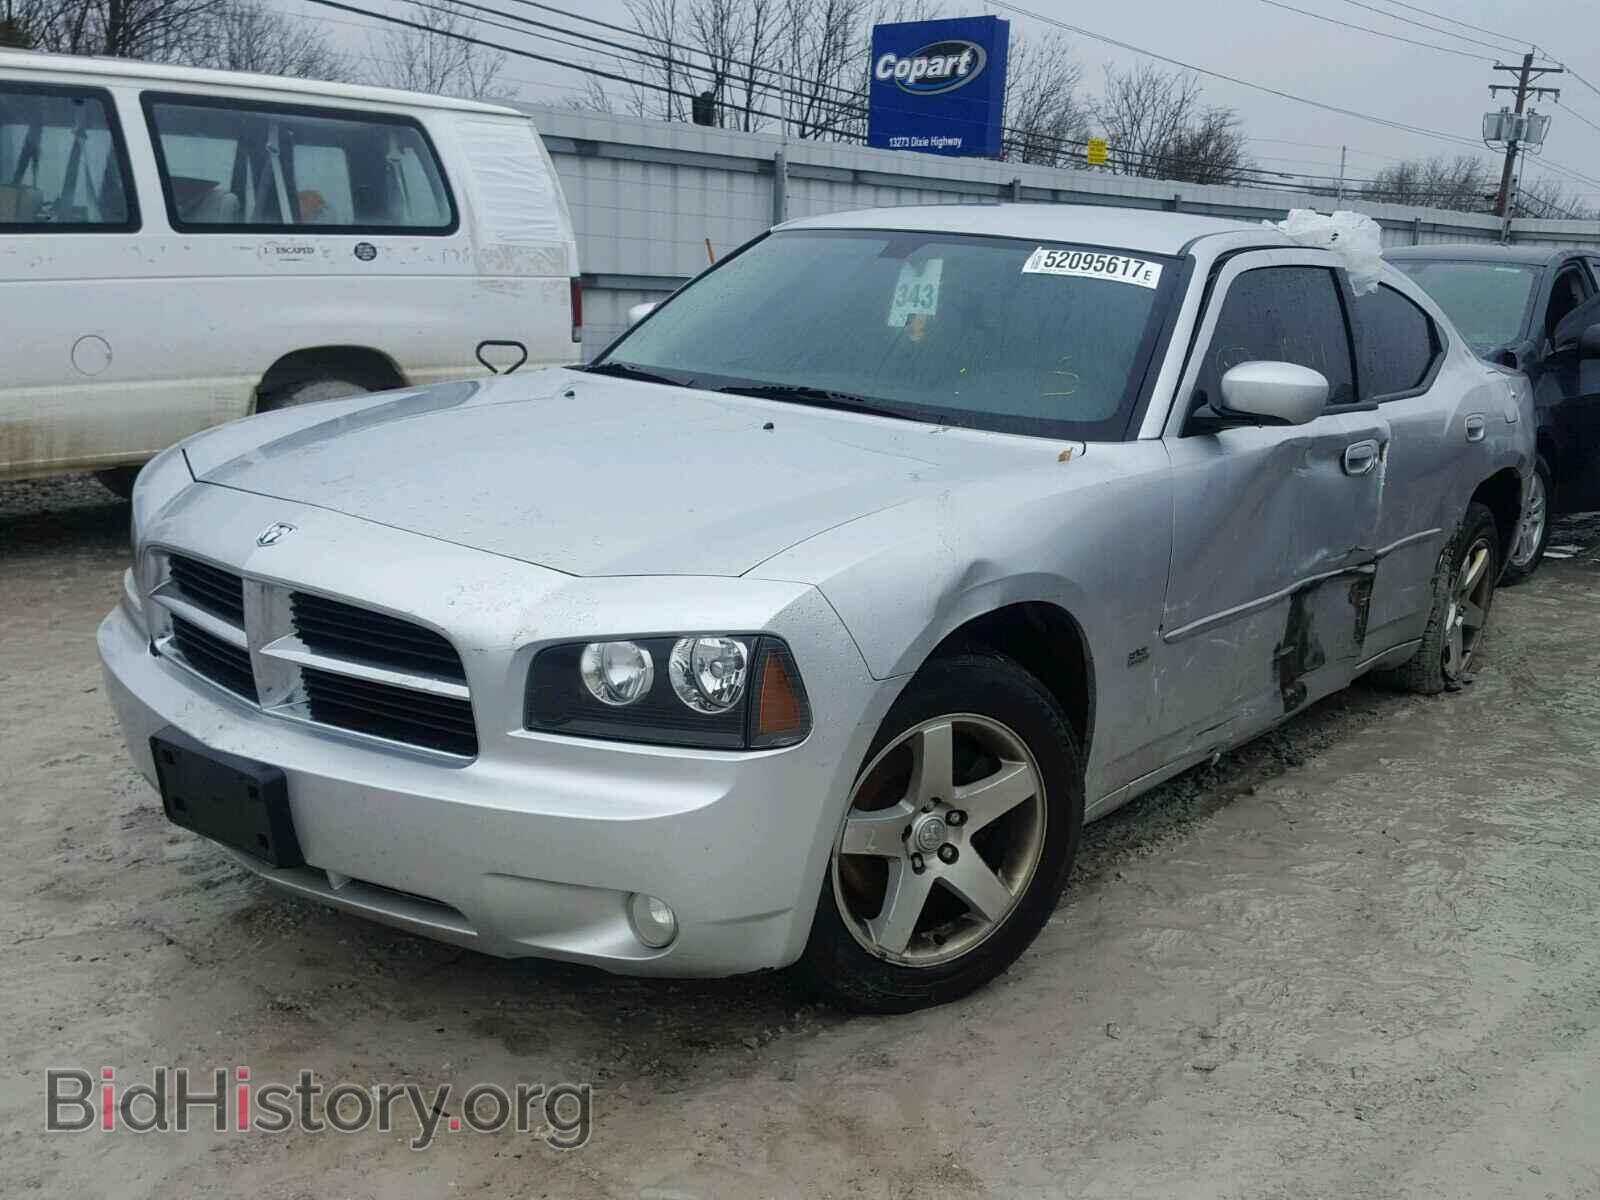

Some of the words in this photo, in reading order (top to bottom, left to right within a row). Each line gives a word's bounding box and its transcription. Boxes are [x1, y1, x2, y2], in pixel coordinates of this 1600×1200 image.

[876, 47, 974, 84] Copart
[889, 137, 910, 147] 13273
[911, 136, 929, 147] Dixie
[930, 136, 962, 149] Highway
[1044, 251, 1146, 278] 52095617
[1143, 270, 1153, 281] E
